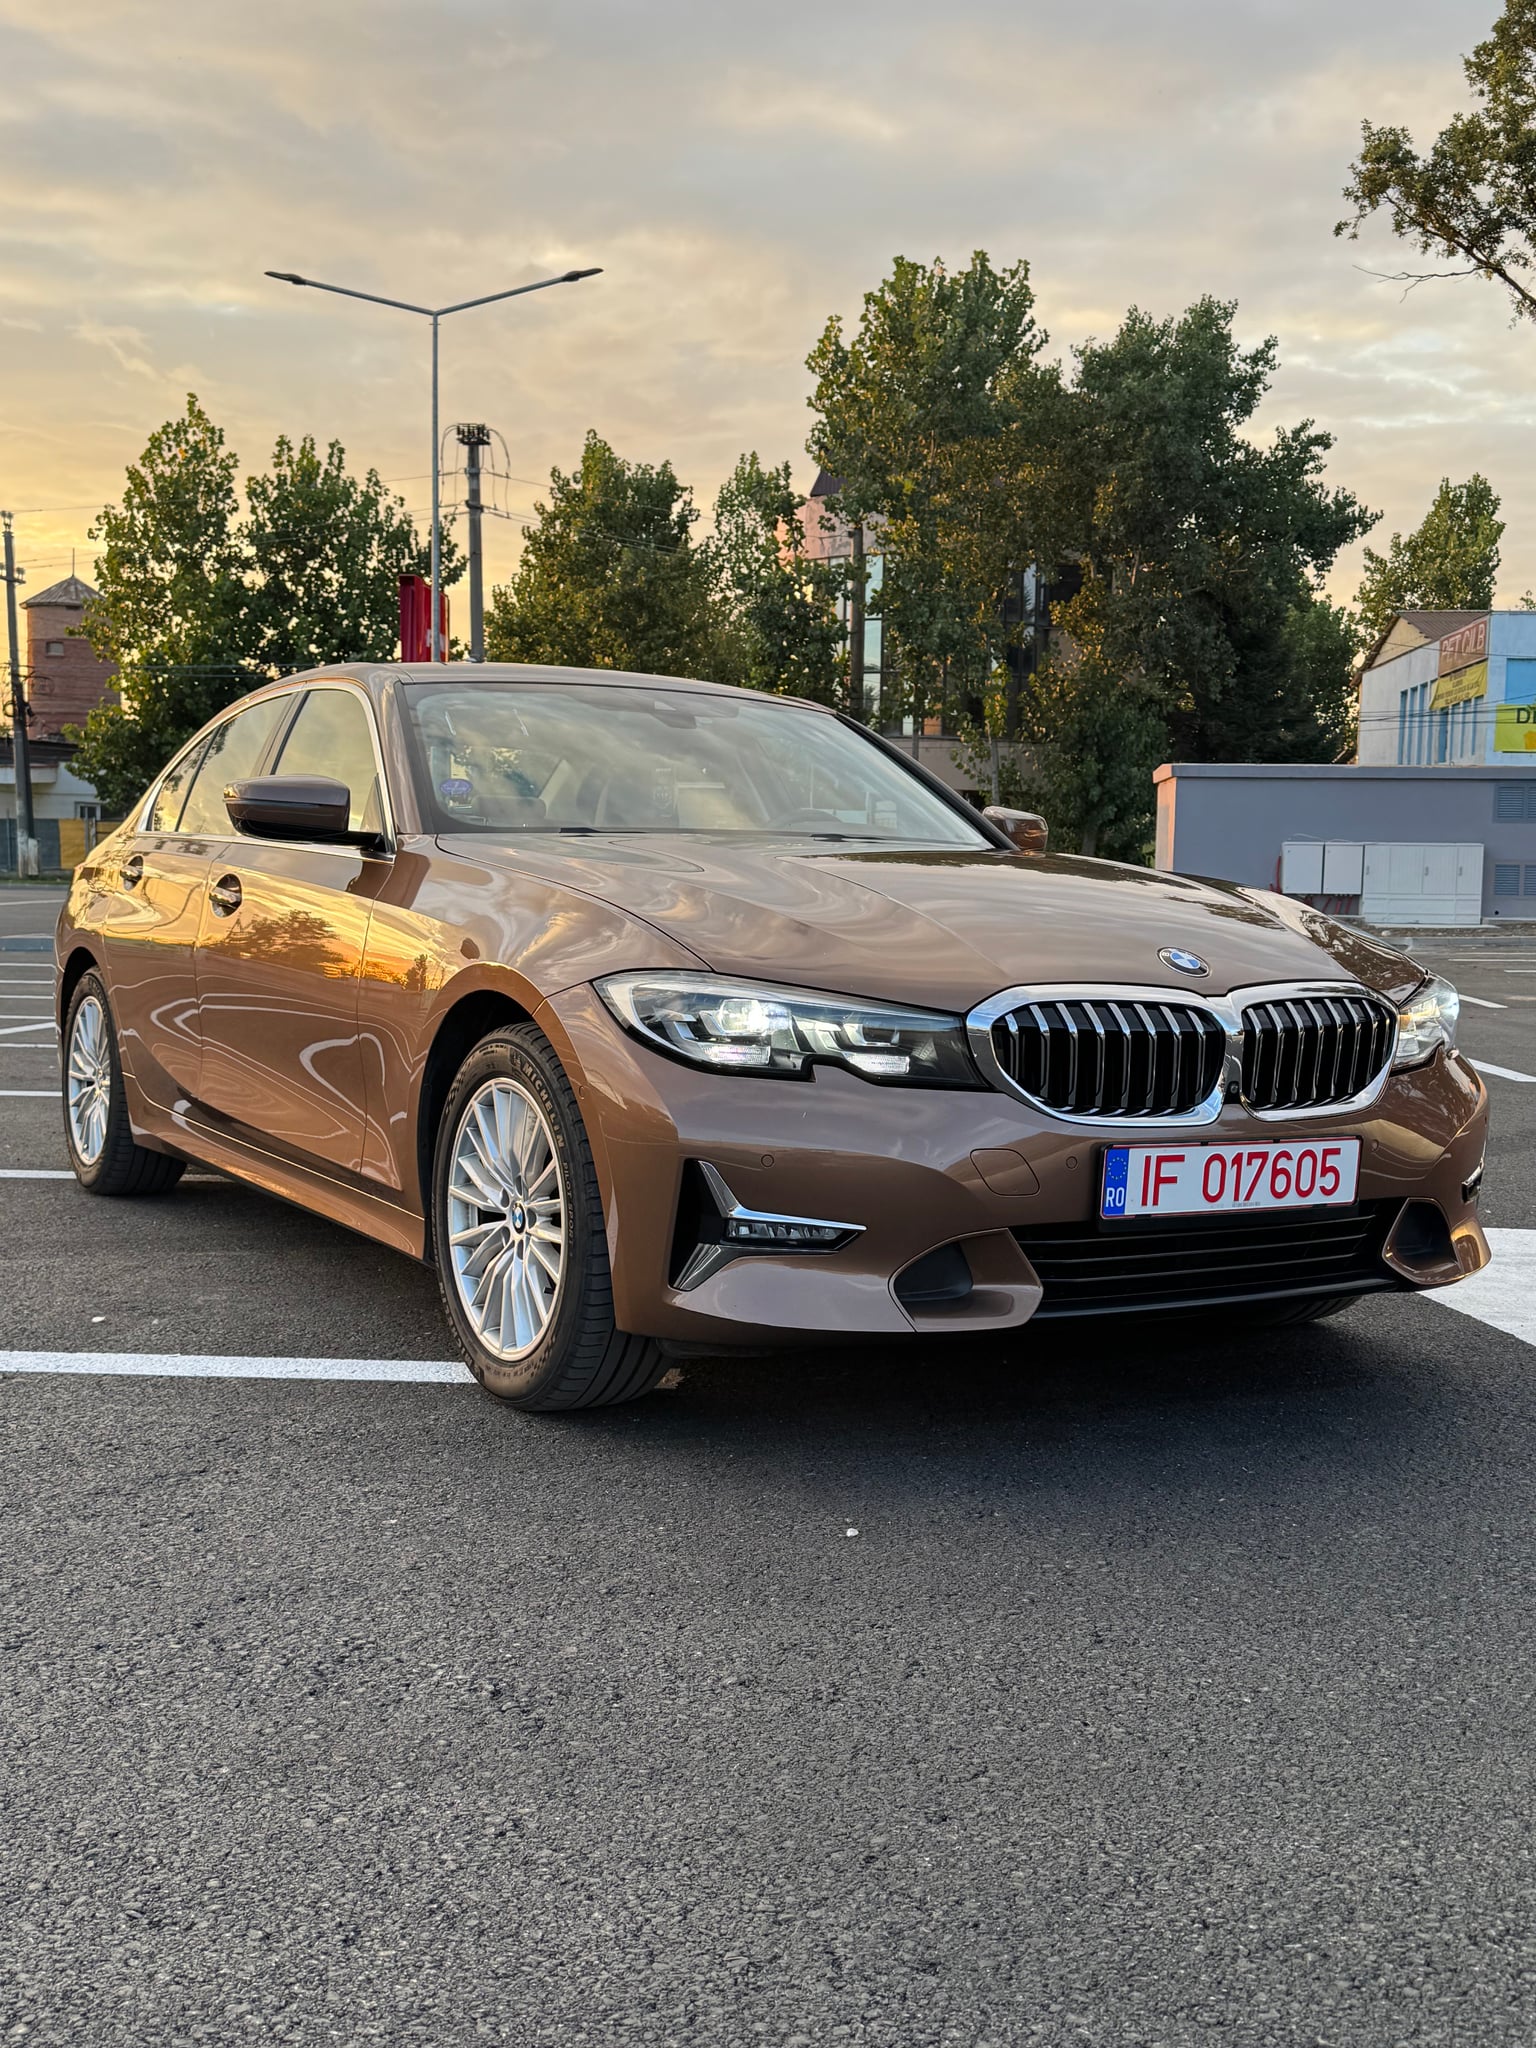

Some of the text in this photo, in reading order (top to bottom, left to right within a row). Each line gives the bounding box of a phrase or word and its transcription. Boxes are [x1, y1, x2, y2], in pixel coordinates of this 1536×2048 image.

[522, 1061, 566, 1149] MICHELIN
[562, 1162, 573, 1199] PILOT
[1105, 1187, 1125, 1208] RO
[1141, 1147, 1341, 1206] IF 017605
